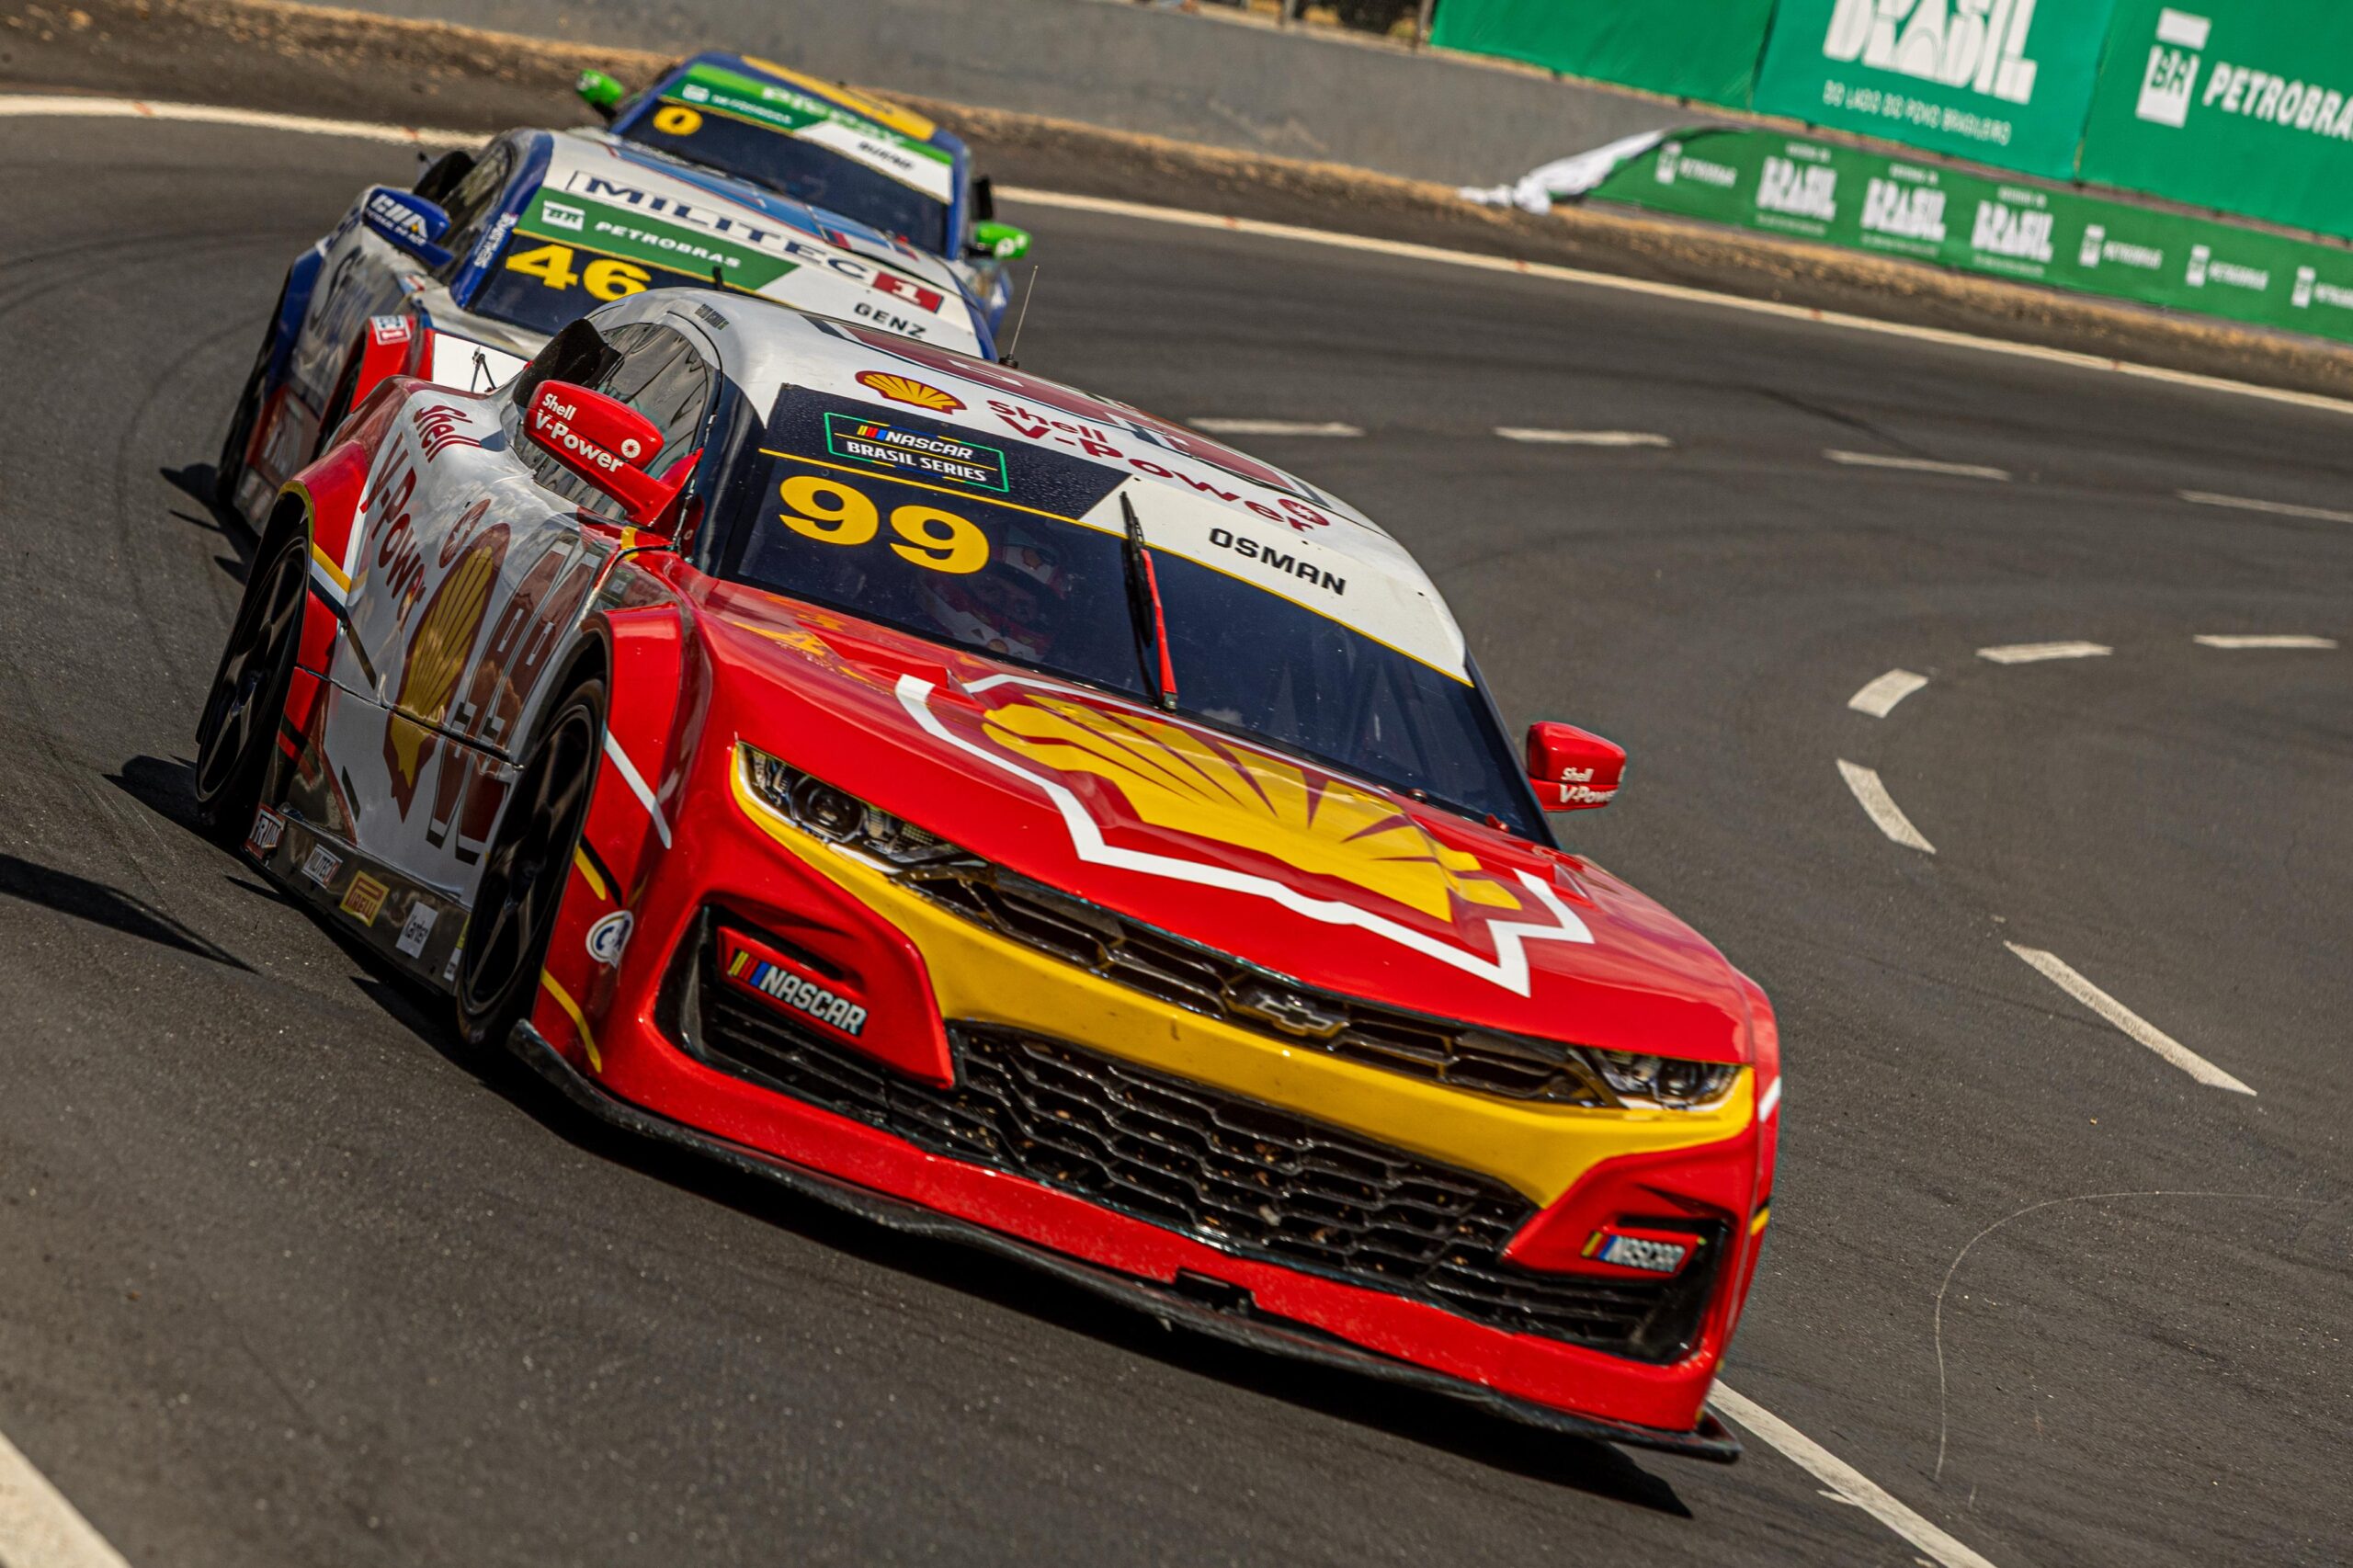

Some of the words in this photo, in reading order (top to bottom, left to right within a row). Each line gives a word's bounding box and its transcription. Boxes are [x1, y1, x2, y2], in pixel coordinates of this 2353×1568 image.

[654, 106, 702, 135] 0
[586, 177, 869, 279] MILITEC
[891, 279, 921, 304] 1
[596, 221, 742, 268] PETROBRAS
[506, 244, 652, 301] 46
[854, 302, 927, 339] GENZ
[542, 393, 577, 421] Shell
[987, 400, 1109, 443] Shell
[535, 409, 625, 472] V-Power
[846, 441, 917, 467] BRASIL
[920, 457, 987, 483] SERIES
[884, 430, 974, 460] NASCAR
[996, 413, 1315, 533] V-Power
[779, 475, 990, 574] 99
[1209, 527, 1347, 596] OSMAN
[1561, 767, 1595, 782] Shell
[345, 876, 385, 920] PIRELLI
[759, 966, 868, 1035] NASCAR
[1606, 1235, 1685, 1272] NASCAR
